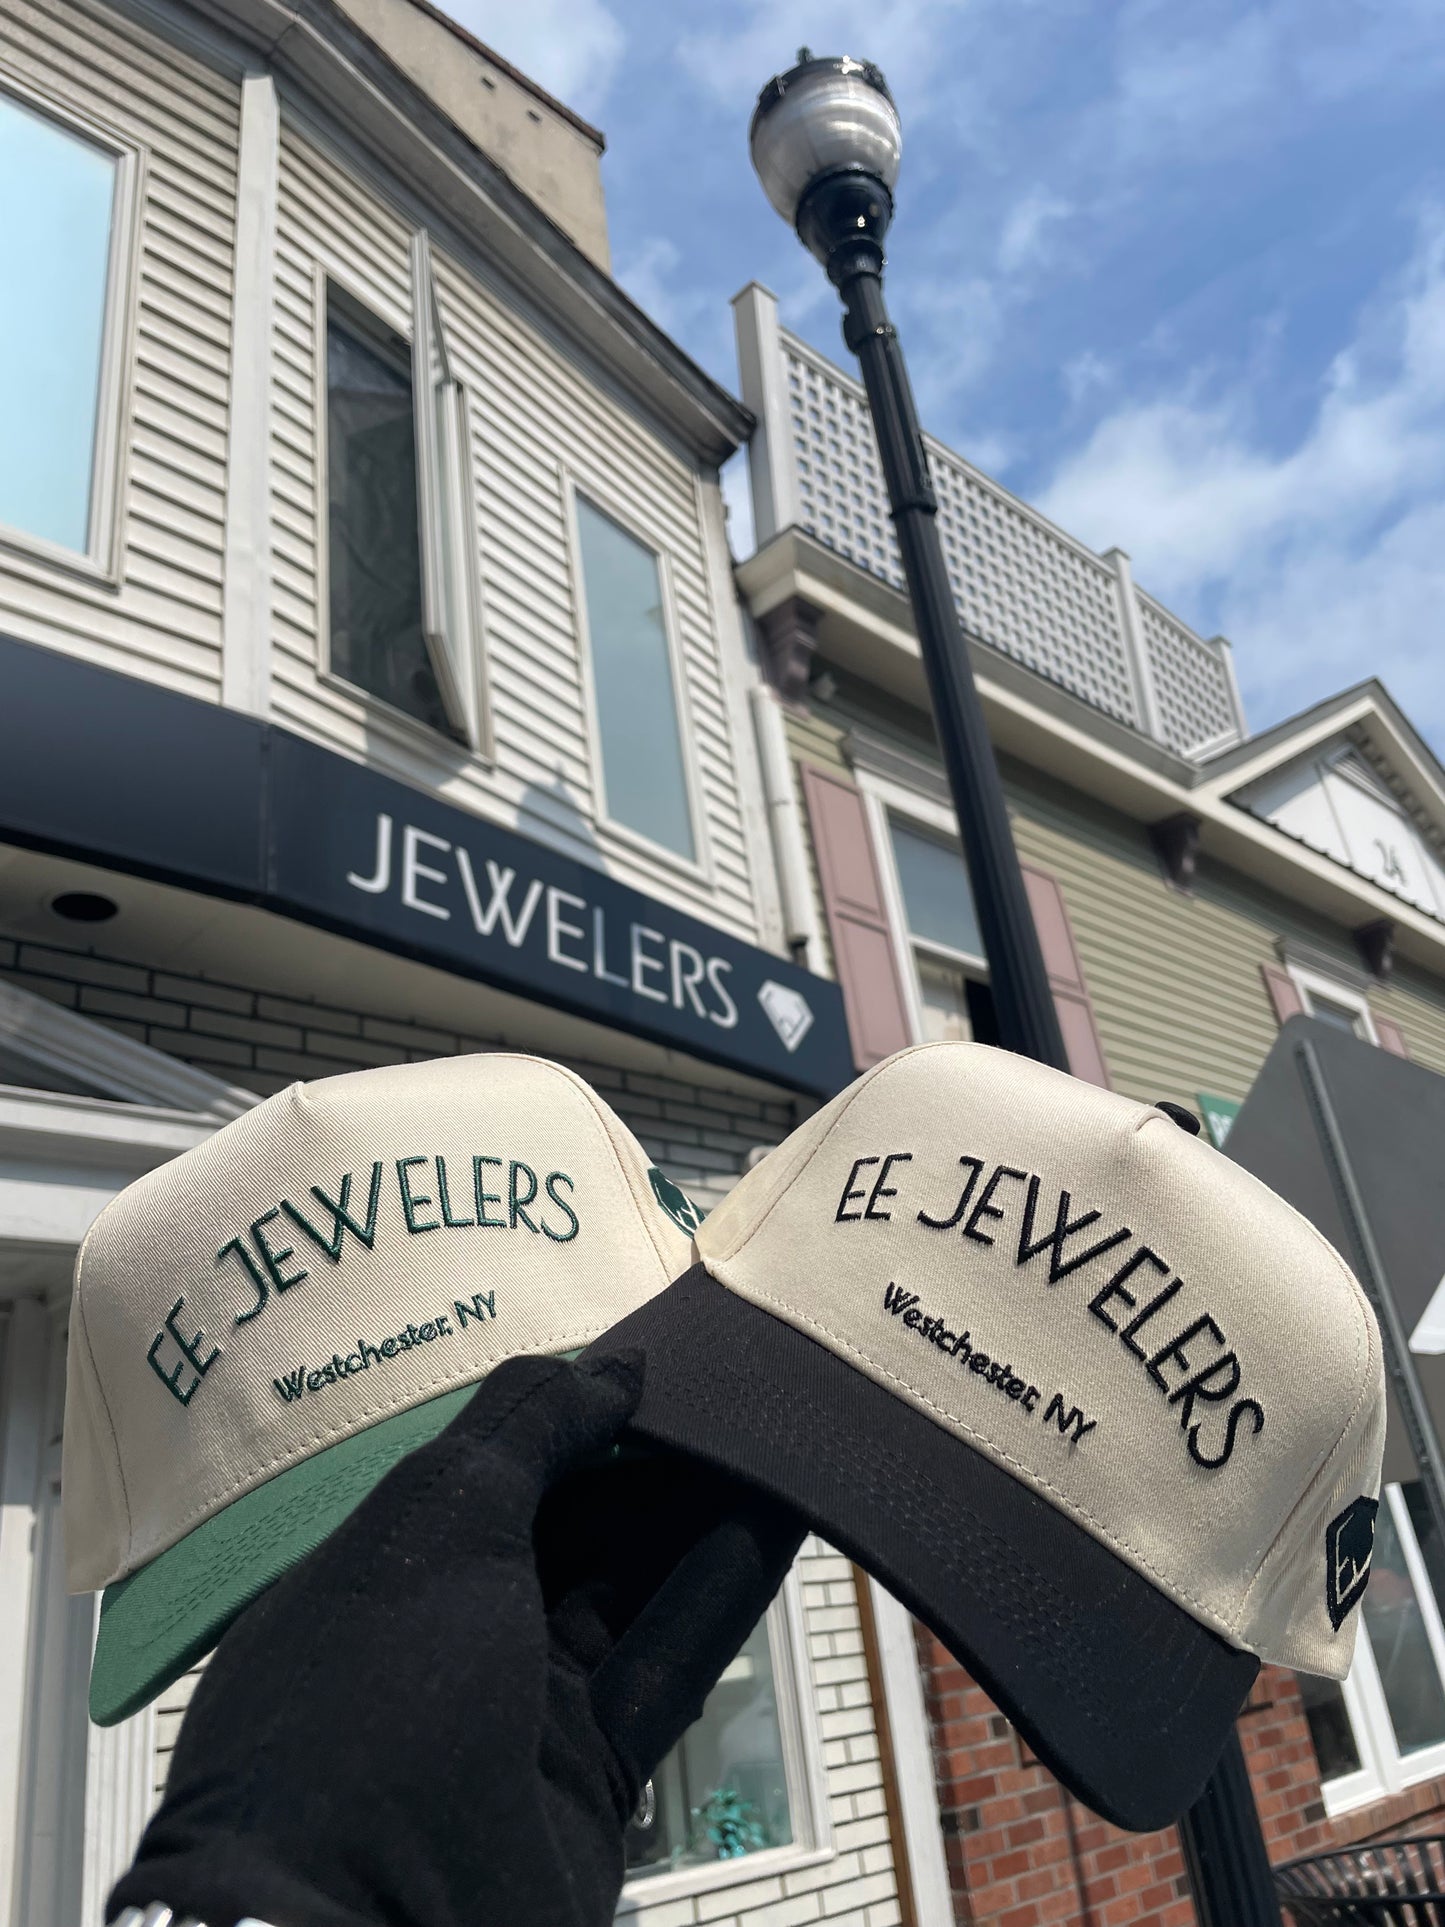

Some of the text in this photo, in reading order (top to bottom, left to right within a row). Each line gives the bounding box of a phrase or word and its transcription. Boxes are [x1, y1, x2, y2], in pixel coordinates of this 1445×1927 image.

[347, 812, 738, 1028] JEWELERS
[145, 1154, 579, 1406] EE JEWELERS
[453, 1289, 497, 1329] NY
[835, 1152, 1264, 1469] EE JEWELERS
[1043, 1393, 1098, 1443] NY
